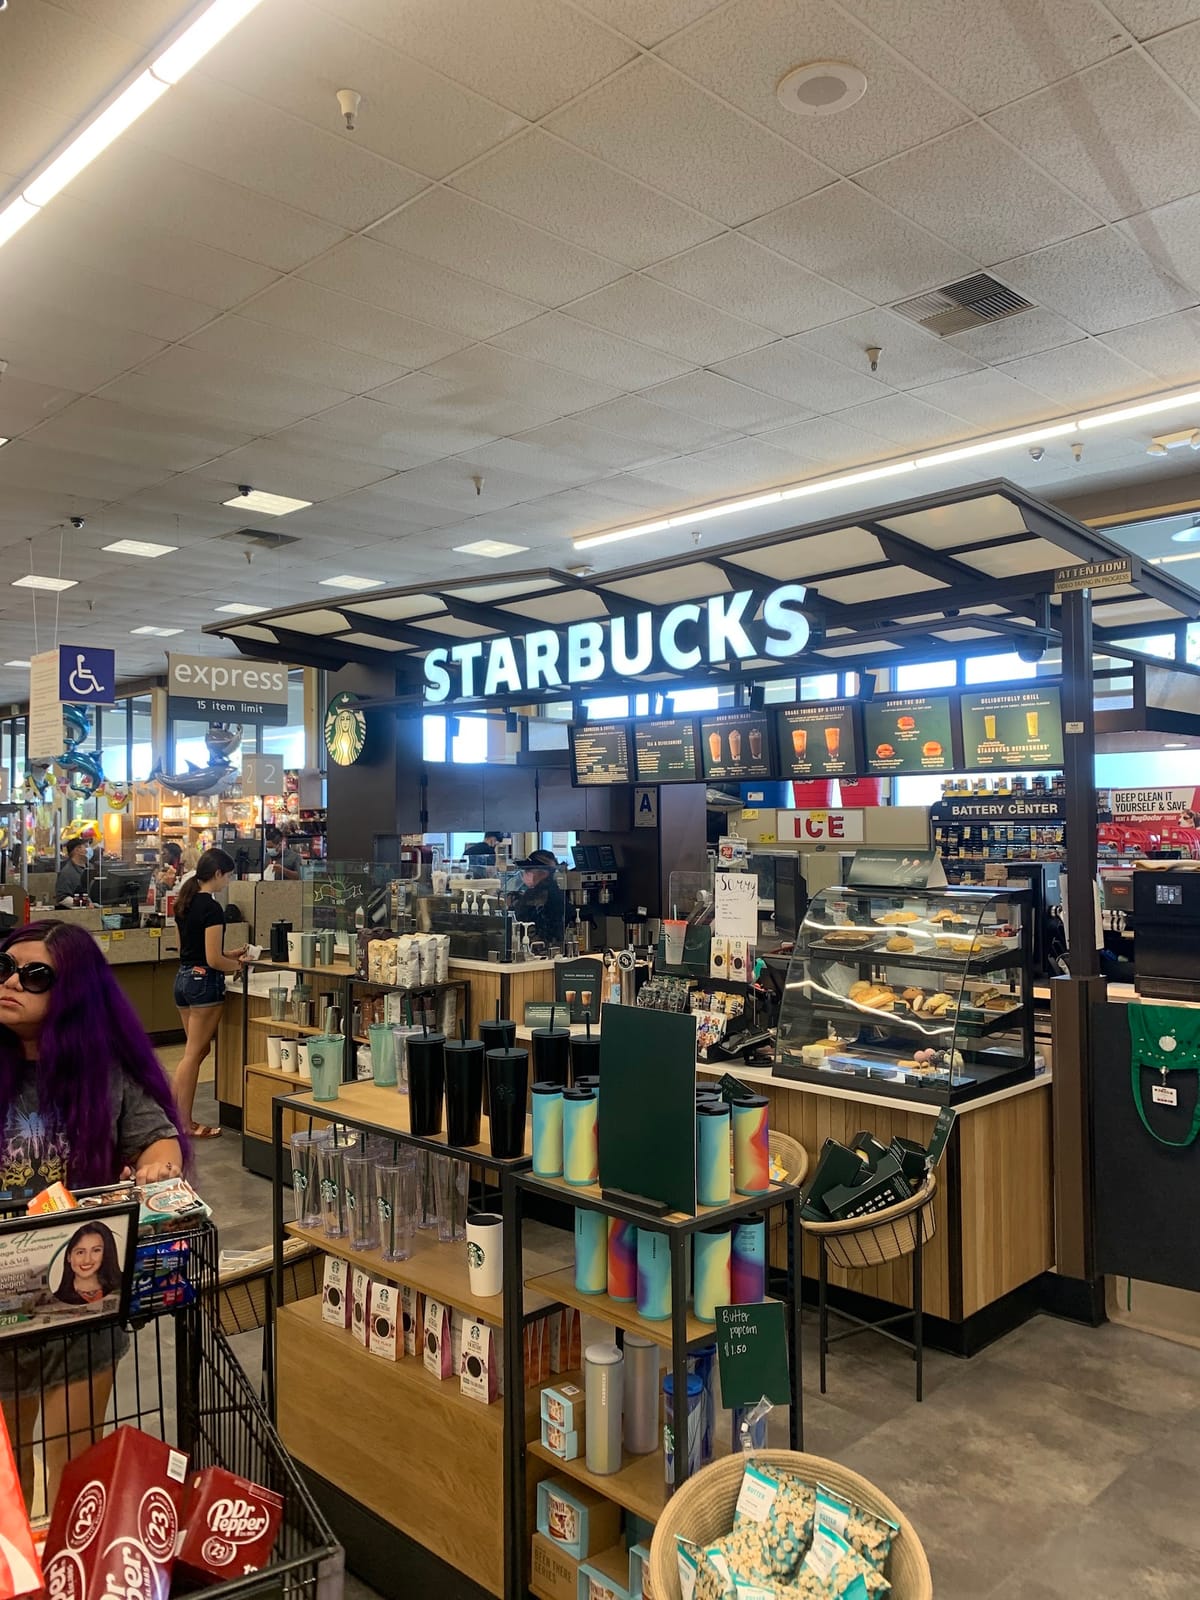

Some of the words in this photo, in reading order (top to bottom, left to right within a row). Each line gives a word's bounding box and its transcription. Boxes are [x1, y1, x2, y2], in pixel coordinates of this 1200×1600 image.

[1058, 560, 1127, 579] ATTENTION!
[1056, 582, 1074, 590] VIDEO
[1074, 579, 1094, 588] TAPING
[1101, 573, 1129, 584] PROGRESS
[424, 584, 810, 702] STARBUCKS
[174, 663, 283, 692] express
[196, 700, 206, 710] 15
[212, 701, 236, 712] item
[241, 703, 264, 714] limit
[263, 763, 276, 784] 2
[640, 793, 652, 812] A
[1115, 792, 1136, 803] DEEP
[1137, 792, 1163, 802] CLEAN
[1165, 791, 1173, 801] IT
[1115, 801, 1157, 813] YOURSELF
[1158, 802, 1165, 811] &
[1167, 801, 1187, 812] SAVE
[952, 804, 1004, 816] BATTERY
[1007, 803, 1059, 815] CENTER
[793, 815, 845, 839] ICE
[720, 874, 756, 900] Sorry
[722, 1308, 750, 1324] Butter
[75, 1501, 96, 1533] 23
[210, 1498, 266, 1538] Pepper
[231, 1499, 256, 1518] Dr
[148, 1510, 169, 1541] 23
[210, 1543, 226, 1559] 23
[534, 1549, 552, 1569] BEEN
[552, 1559, 572, 1584] THERE
[534, 1560, 557, 1585] SERIES
